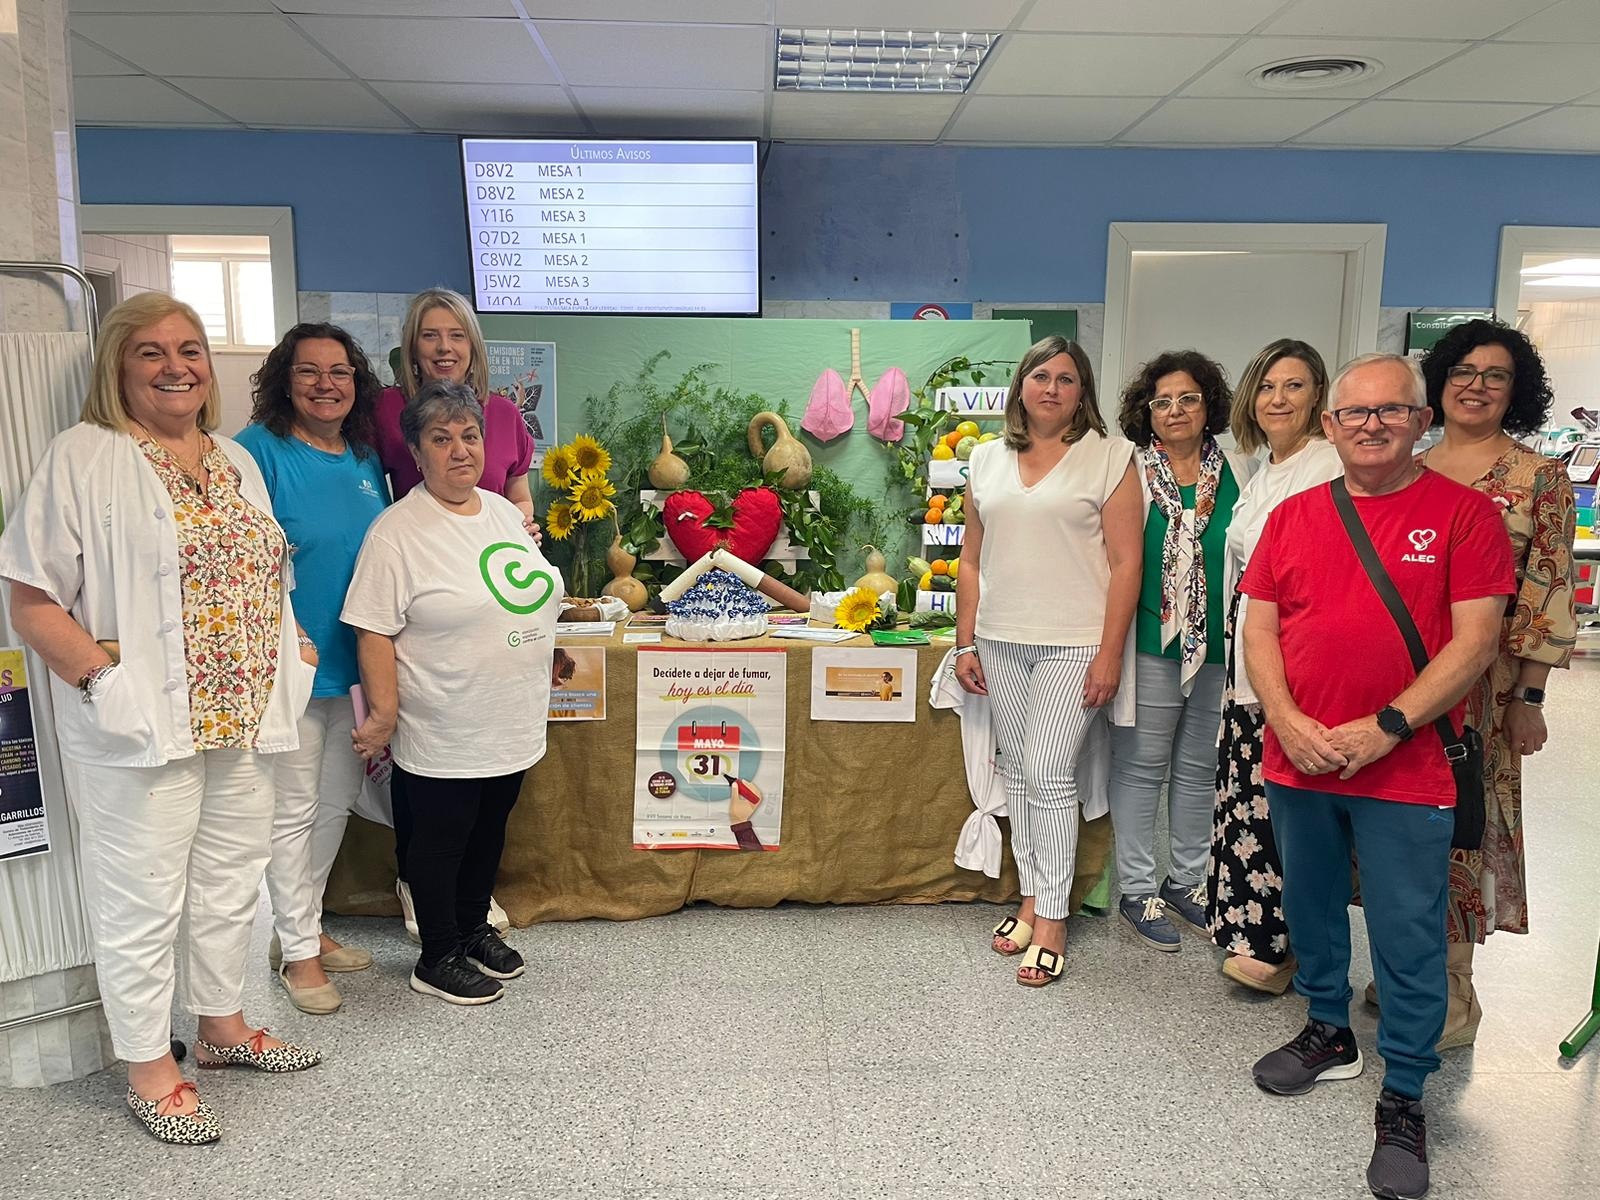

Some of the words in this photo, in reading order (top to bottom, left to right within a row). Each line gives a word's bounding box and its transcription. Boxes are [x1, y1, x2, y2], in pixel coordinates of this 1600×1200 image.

[475, 163, 514, 178] D8V2
[538, 165, 573, 177] MESA
[577, 165, 582, 177] 1
[477, 186, 515, 200] D8V2
[540, 187, 574, 200] MESA
[577, 188, 585, 200] 2
[480, 208, 514, 223] Y1I6
[541, 210, 575, 222] MESA
[578, 210, 586, 222] 3
[479, 231, 520, 247] Q7D2
[542, 232, 577, 244] MESA
[580, 233, 586, 244] 1
[480, 252, 522, 267] C8W2
[544, 254, 578, 266] MESA
[581, 255, 589, 266] 2
[483, 274, 521, 290] J5W2
[545, 276, 579, 288] MESA
[582, 276, 590, 288] 3
[489, 346, 525, 356] EMISIONES
[511, 356, 525, 366] TUS
[1401, 554, 1436, 563] ALEC
[703, 667, 726, 681] dejar
[728, 667, 740, 678] de
[742, 667, 771, 680] fumar,
[667, 682, 694, 704] hoy
[697, 686, 712, 696] es
[715, 680, 729, 695] el
[731, 680, 755, 694] día
[694, 738, 725, 749] MAYO
[693, 754, 720, 776] 31
[0, 806, 45, 822] GARRILLOS
